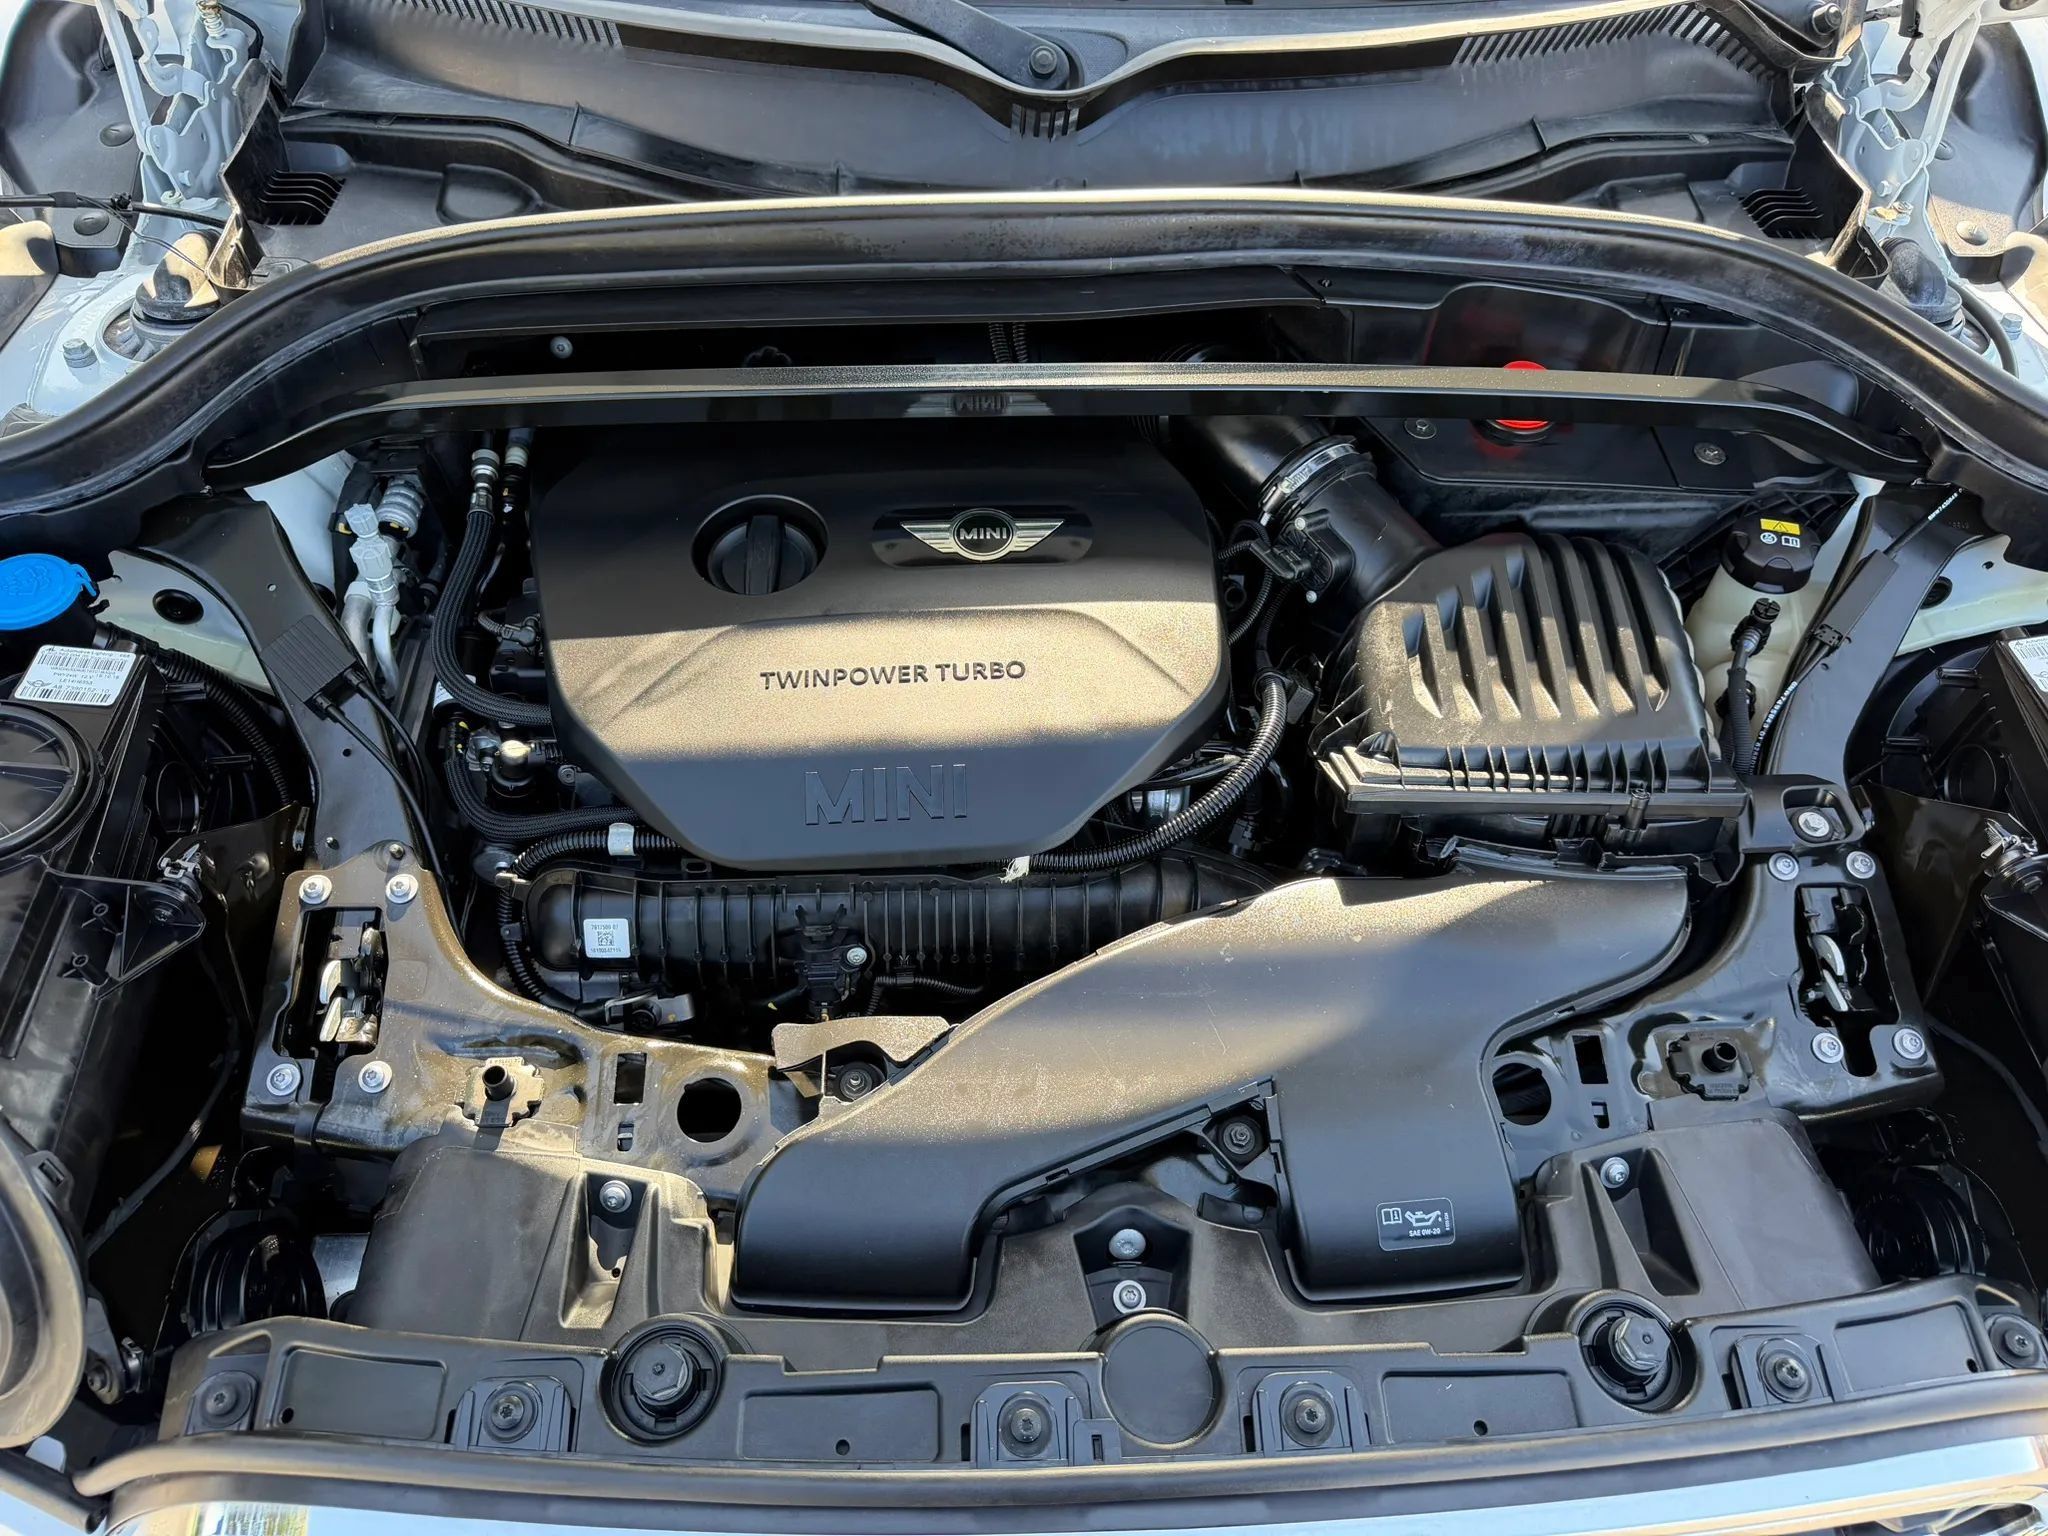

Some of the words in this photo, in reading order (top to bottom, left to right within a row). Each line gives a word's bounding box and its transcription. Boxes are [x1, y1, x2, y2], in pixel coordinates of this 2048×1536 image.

[959, 527, 1008, 541] MINI
[760, 665, 929, 690] TWINPOWER
[935, 660, 1026, 682] TURBO
[805, 764, 967, 825] MINI
[1409, 1229, 1421, 1237] SAE
[1421, 1227, 1441, 1236] 0W-20
